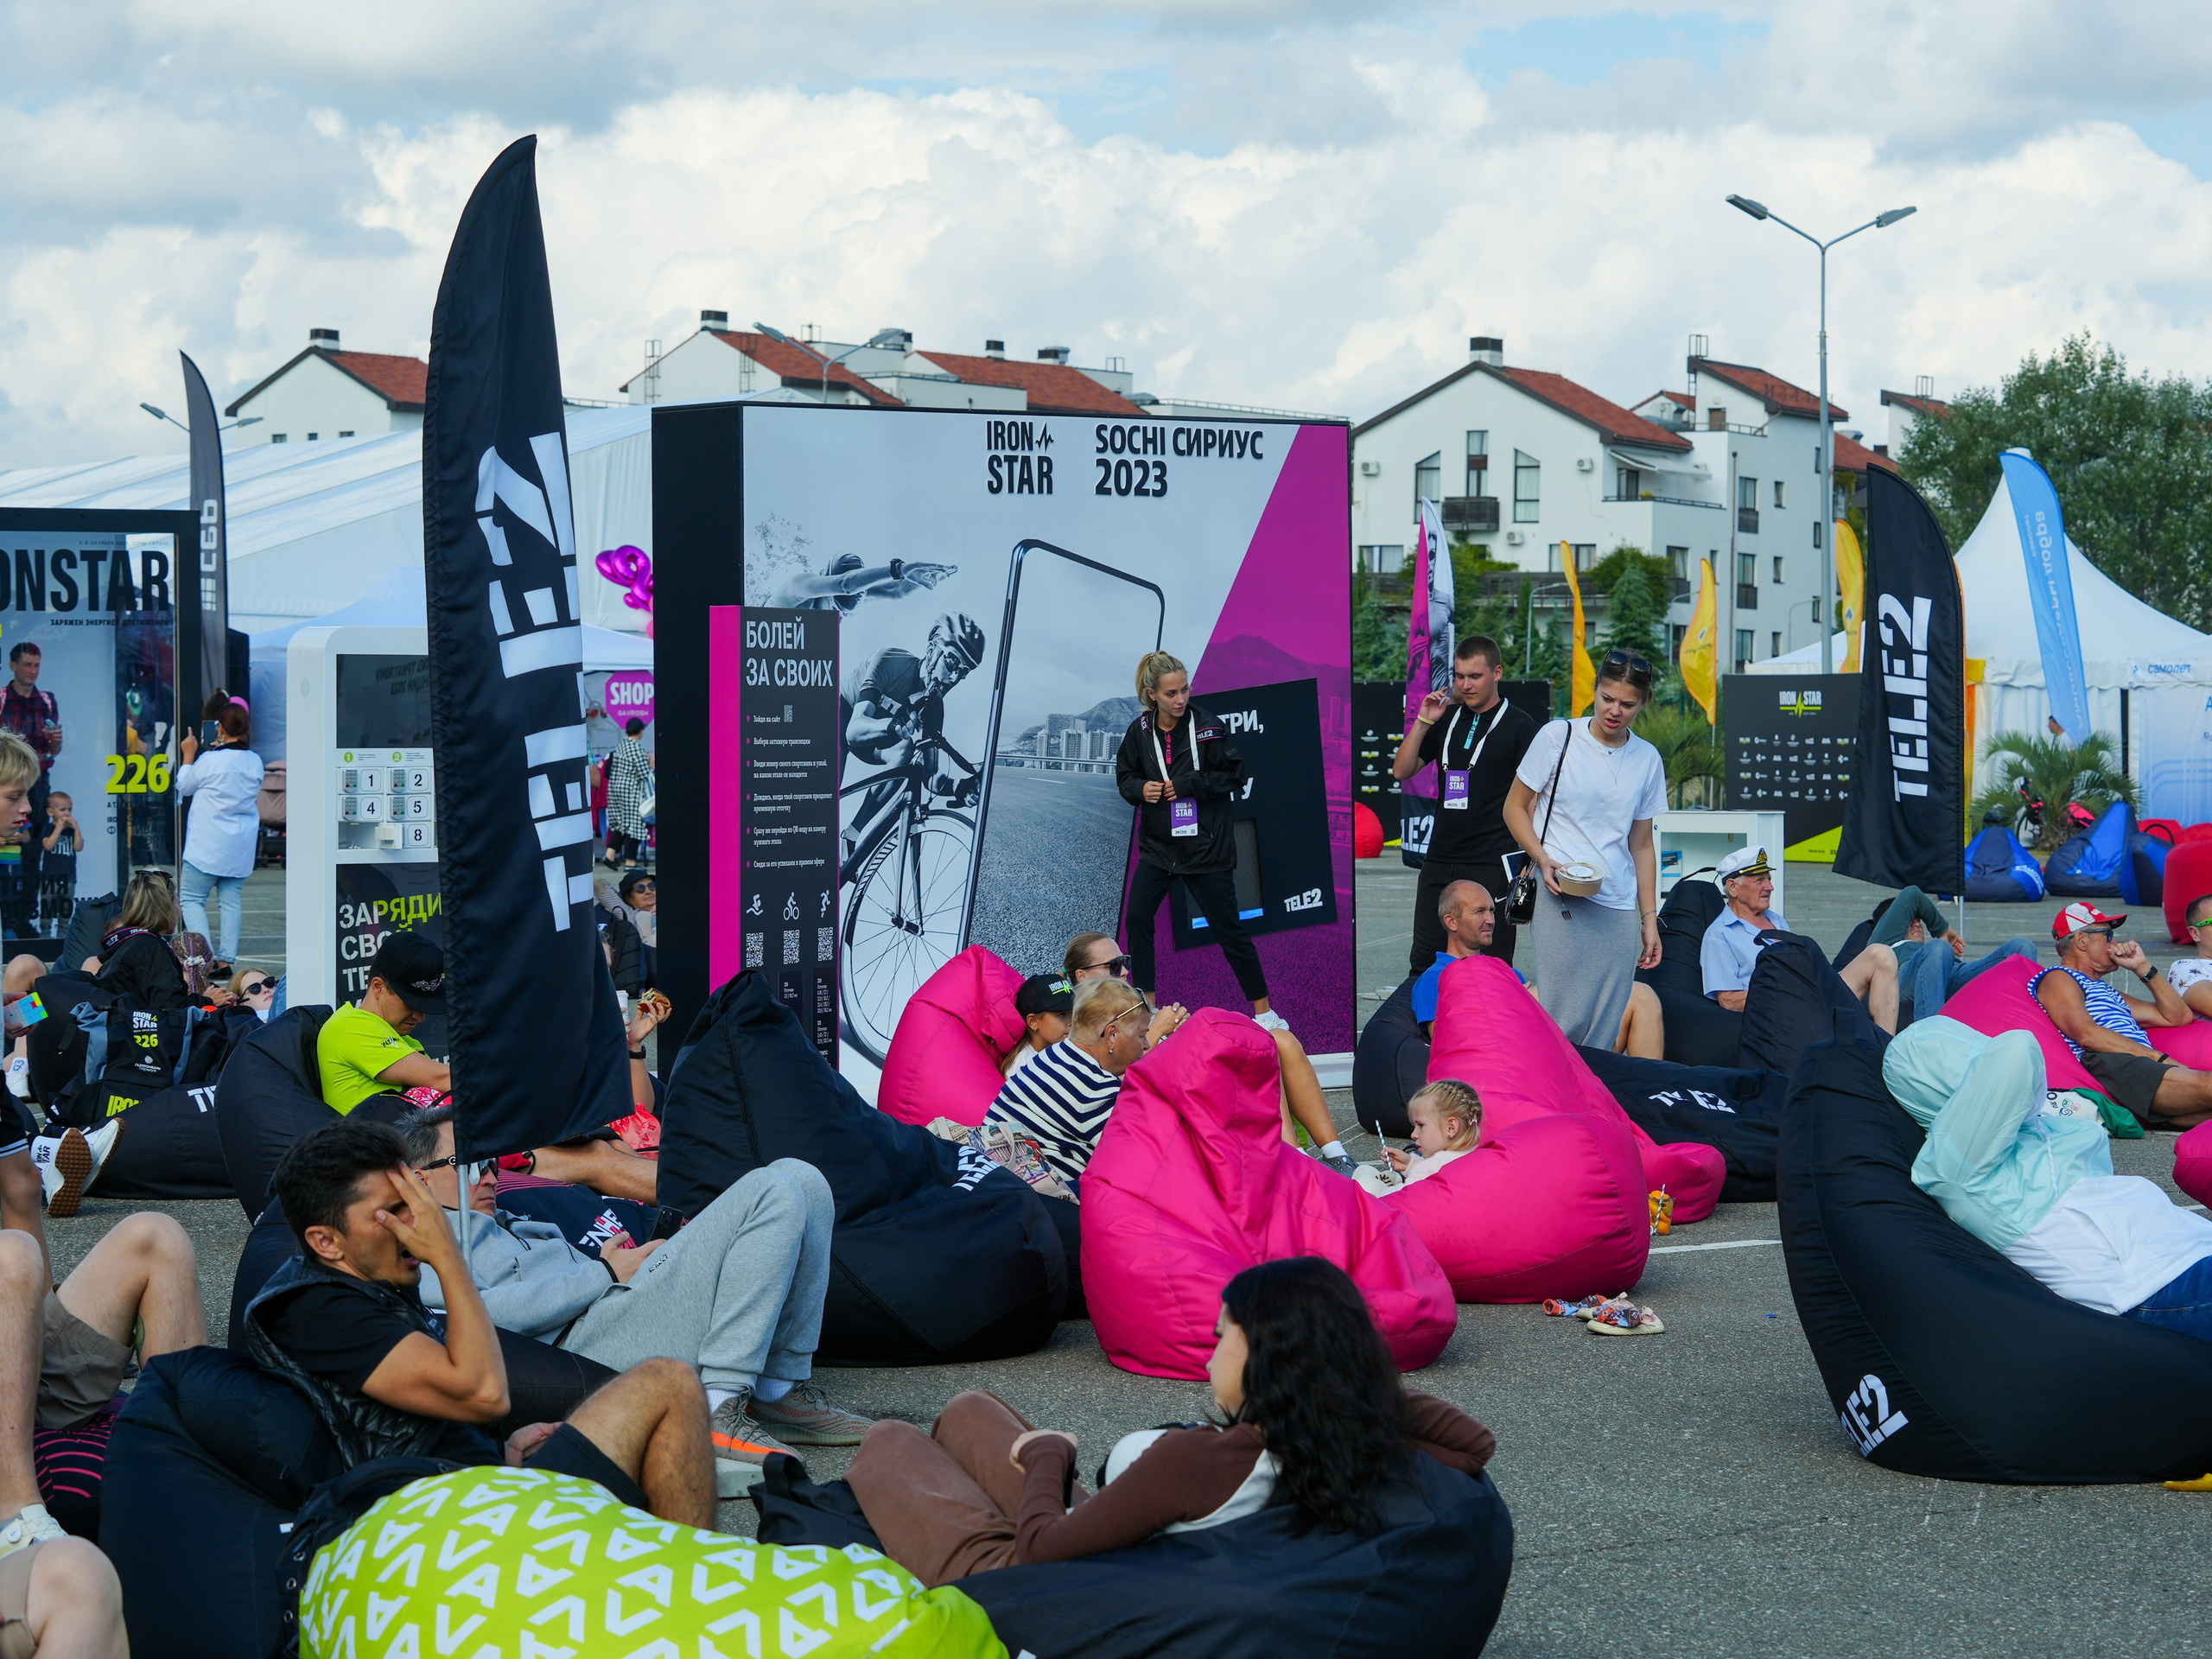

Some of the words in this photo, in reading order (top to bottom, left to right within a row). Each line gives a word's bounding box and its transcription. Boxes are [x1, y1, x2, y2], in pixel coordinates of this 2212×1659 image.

[986, 420, 1033, 451] IRON
[1095, 423, 1166, 454] SOCHI
[1172, 427, 1263, 460] СИРИУС
[987, 454, 1053, 495] STAR
[1094, 458, 1167, 497] 2023
[746, 616, 805, 650] БОЛЕЙ
[746, 658, 771, 686] ЗА
[773, 658, 834, 687] СВОИХ
[2147, 664, 2191, 674] самолет
[475, 431, 594, 932] TELE2
[610, 682, 655, 706] SHOP
[1779, 690, 1797, 705] IRON
[1802, 690, 1822, 705] STAR
[1878, 593, 1933, 803] TELE2
[1217, 709, 1264, 734] ТРИ,
[1196, 729, 1214, 740] TELE2
[105, 753, 170, 794] 226
[367, 774, 373, 787] 1
[414, 773, 423, 787] 2
[1449, 781, 1465, 791] STAR
[366, 802, 376, 815] 4
[413, 801, 422, 814] 5
[1175, 808, 1193, 817] STAR
[413, 829, 423, 842] 8
[338, 892, 442, 930] ЗАРЯДИ
[1283, 887, 1324, 912] TELE2
[1048, 980, 1065, 993] IRON
[132, 1011, 152, 1021] IRON
[132, 1017, 158, 1028] STAR
[105, 1095, 140, 1117] IRO
